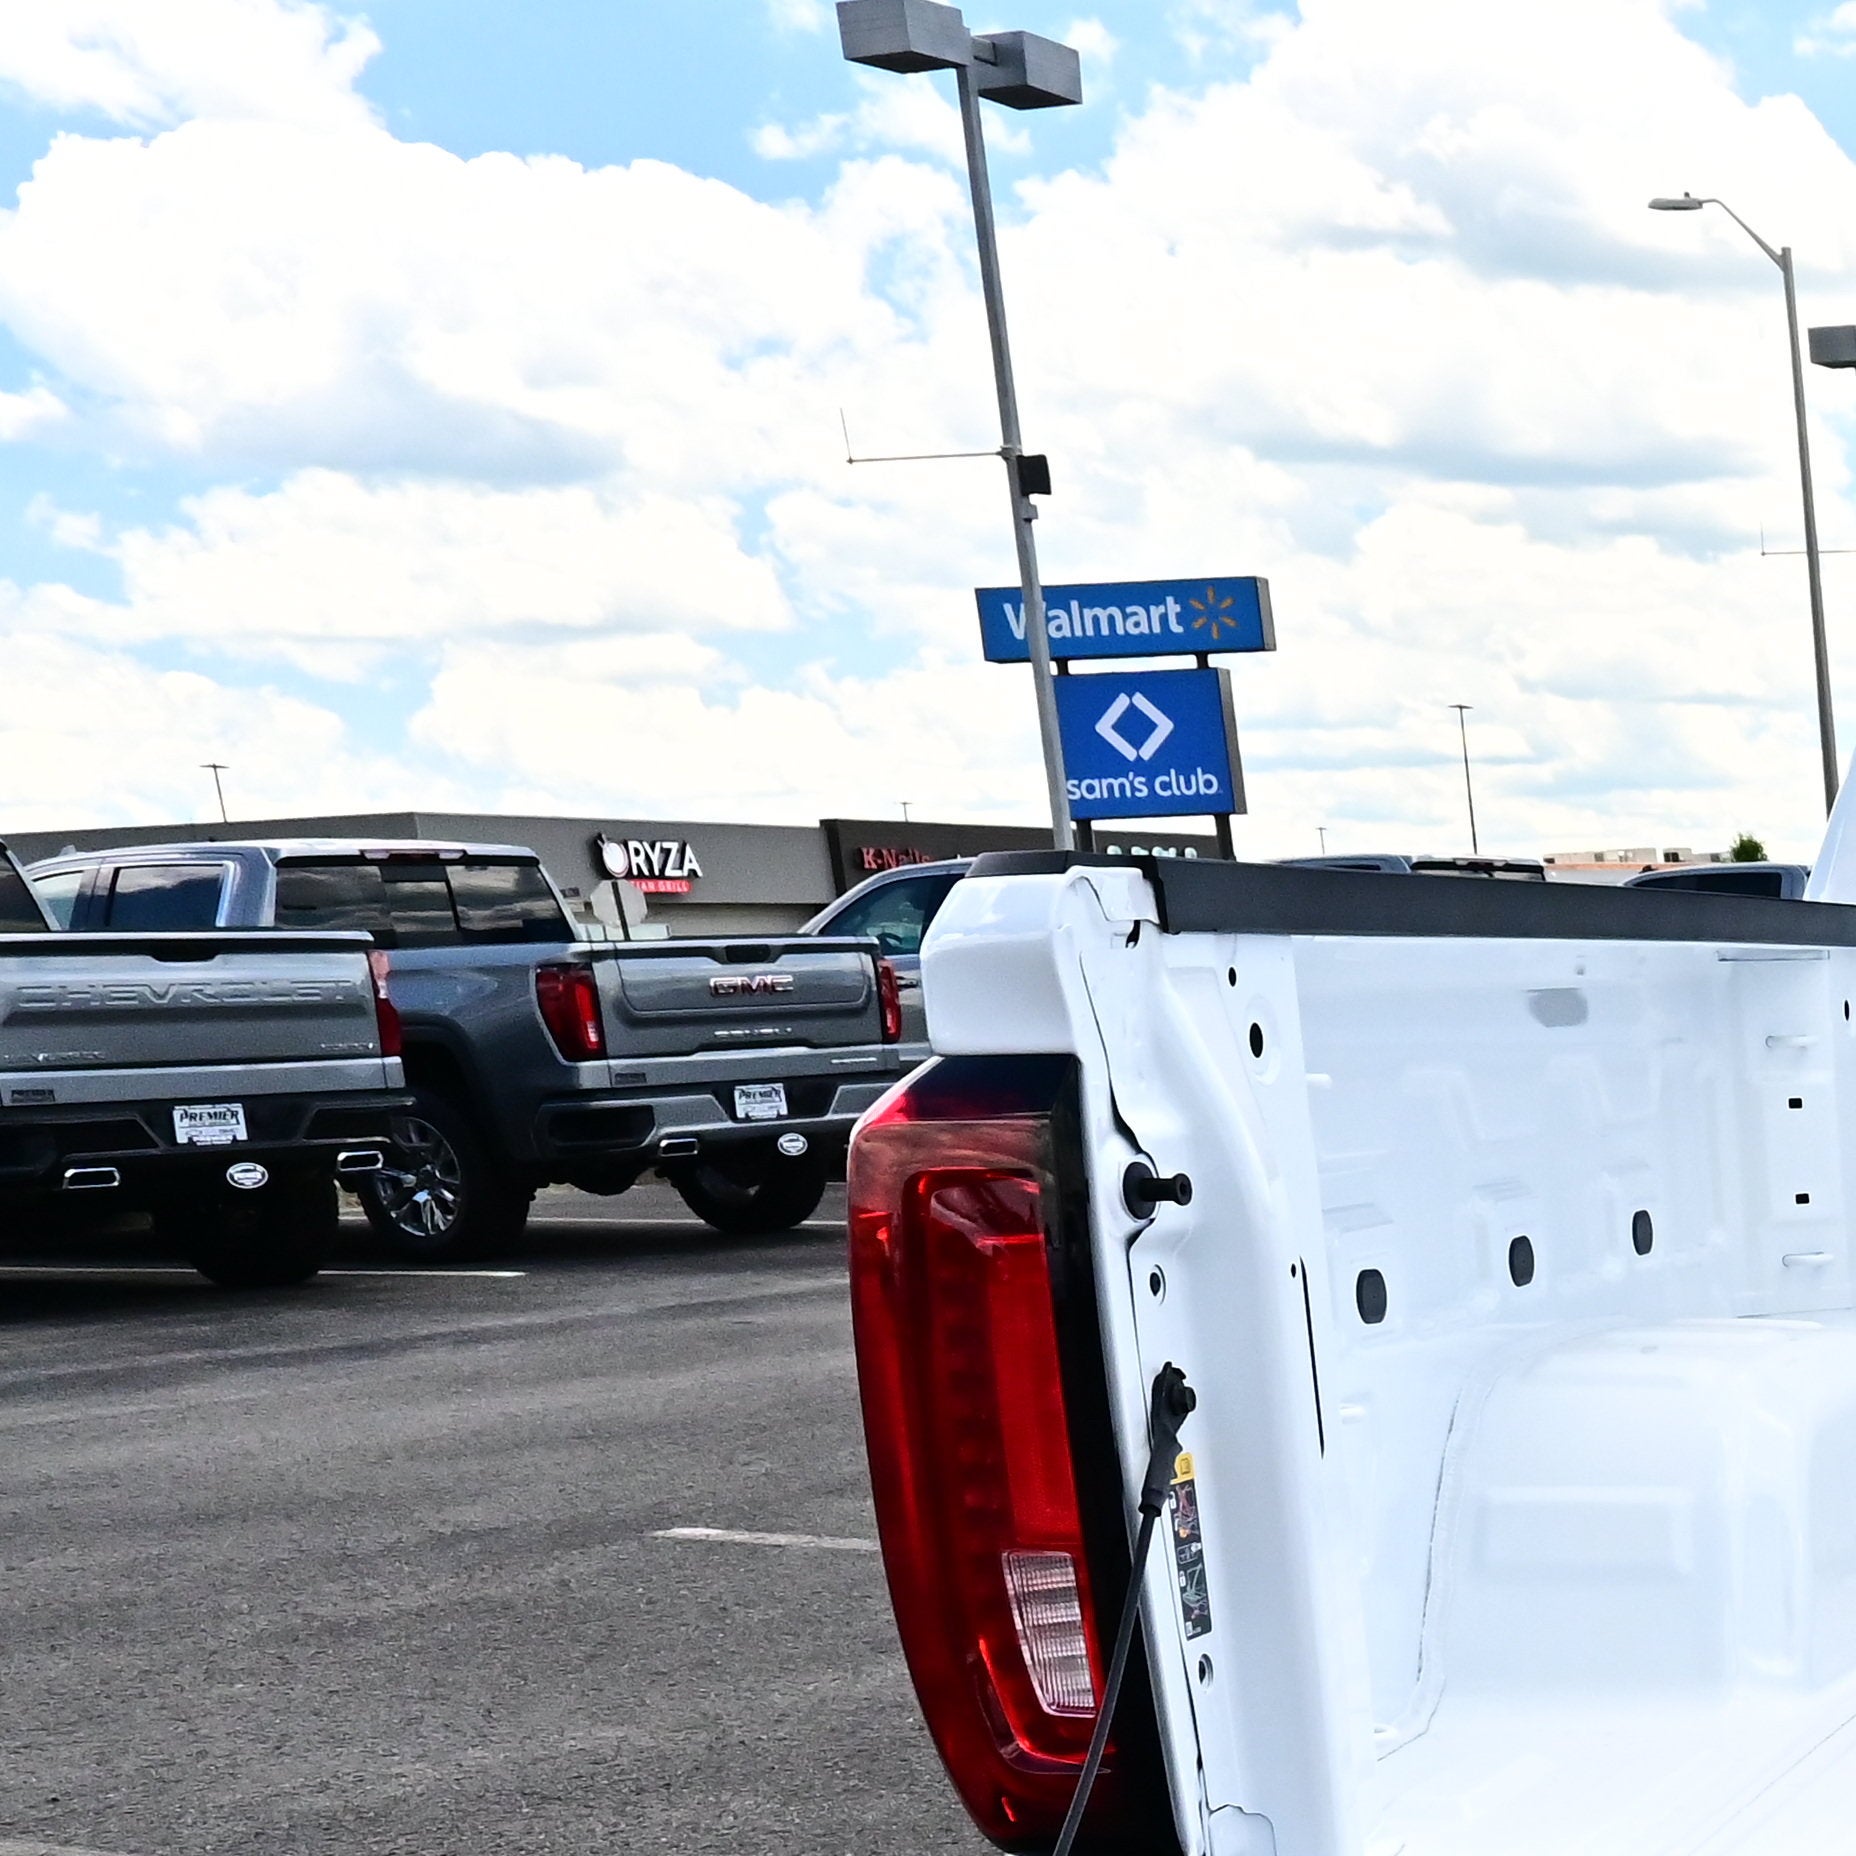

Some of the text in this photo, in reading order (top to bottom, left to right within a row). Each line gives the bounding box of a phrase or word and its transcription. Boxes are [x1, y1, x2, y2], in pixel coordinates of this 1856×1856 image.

[1003, 596, 1184, 640] Walmart
[1067, 767, 1219, 800] sam's club
[15, 979, 355, 1008] CHEVROLET
[709, 974, 794, 997] GMC
[179, 1109, 240, 1125] PREMIER
